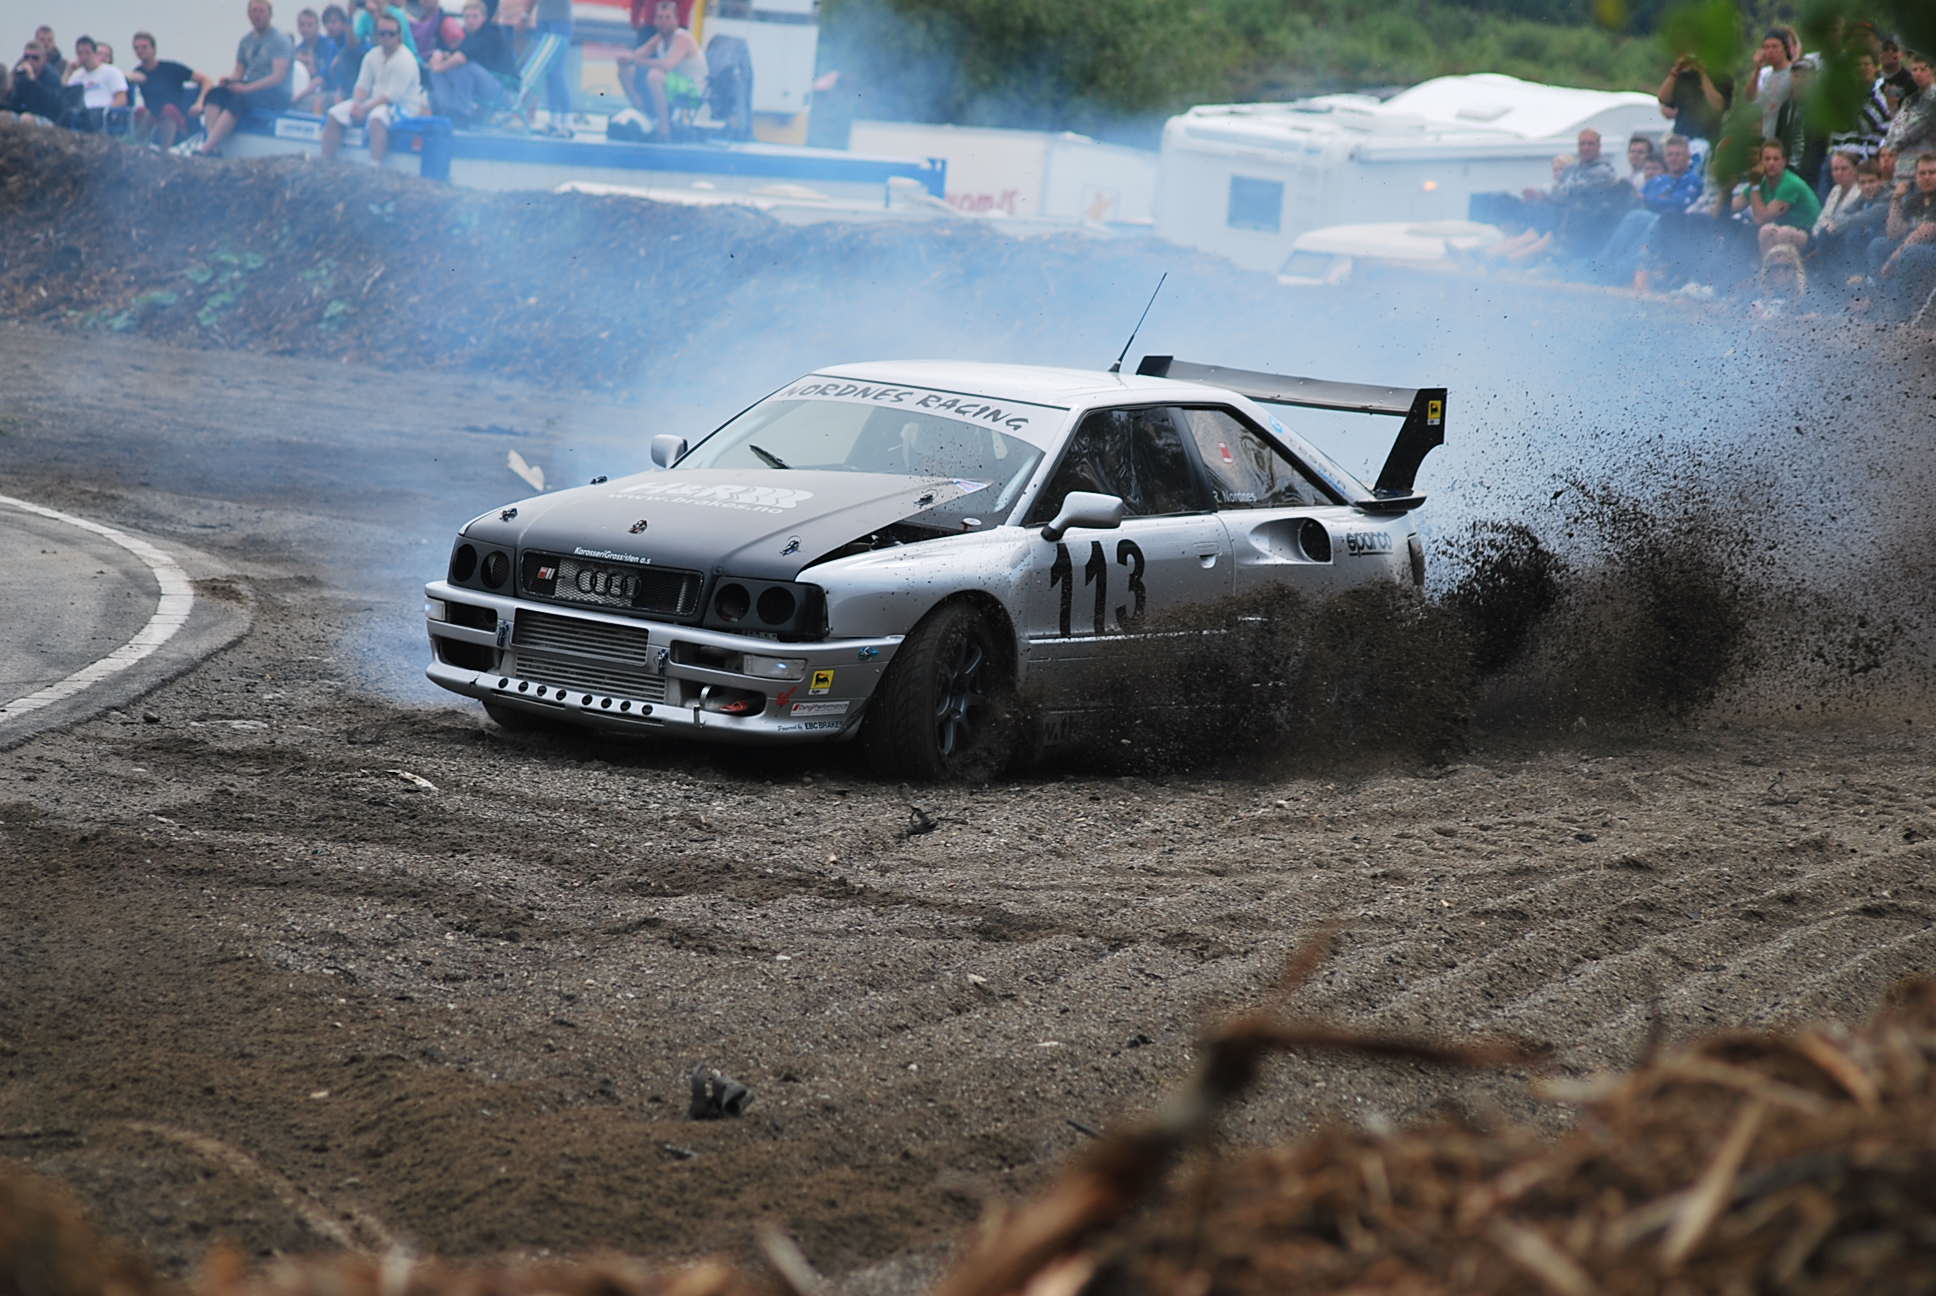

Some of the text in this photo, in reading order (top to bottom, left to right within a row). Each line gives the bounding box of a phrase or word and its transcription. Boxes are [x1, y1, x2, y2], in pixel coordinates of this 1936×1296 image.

[780, 383, 1029, 432] NORDNES RACING
[1050, 538, 1147, 637] 113
